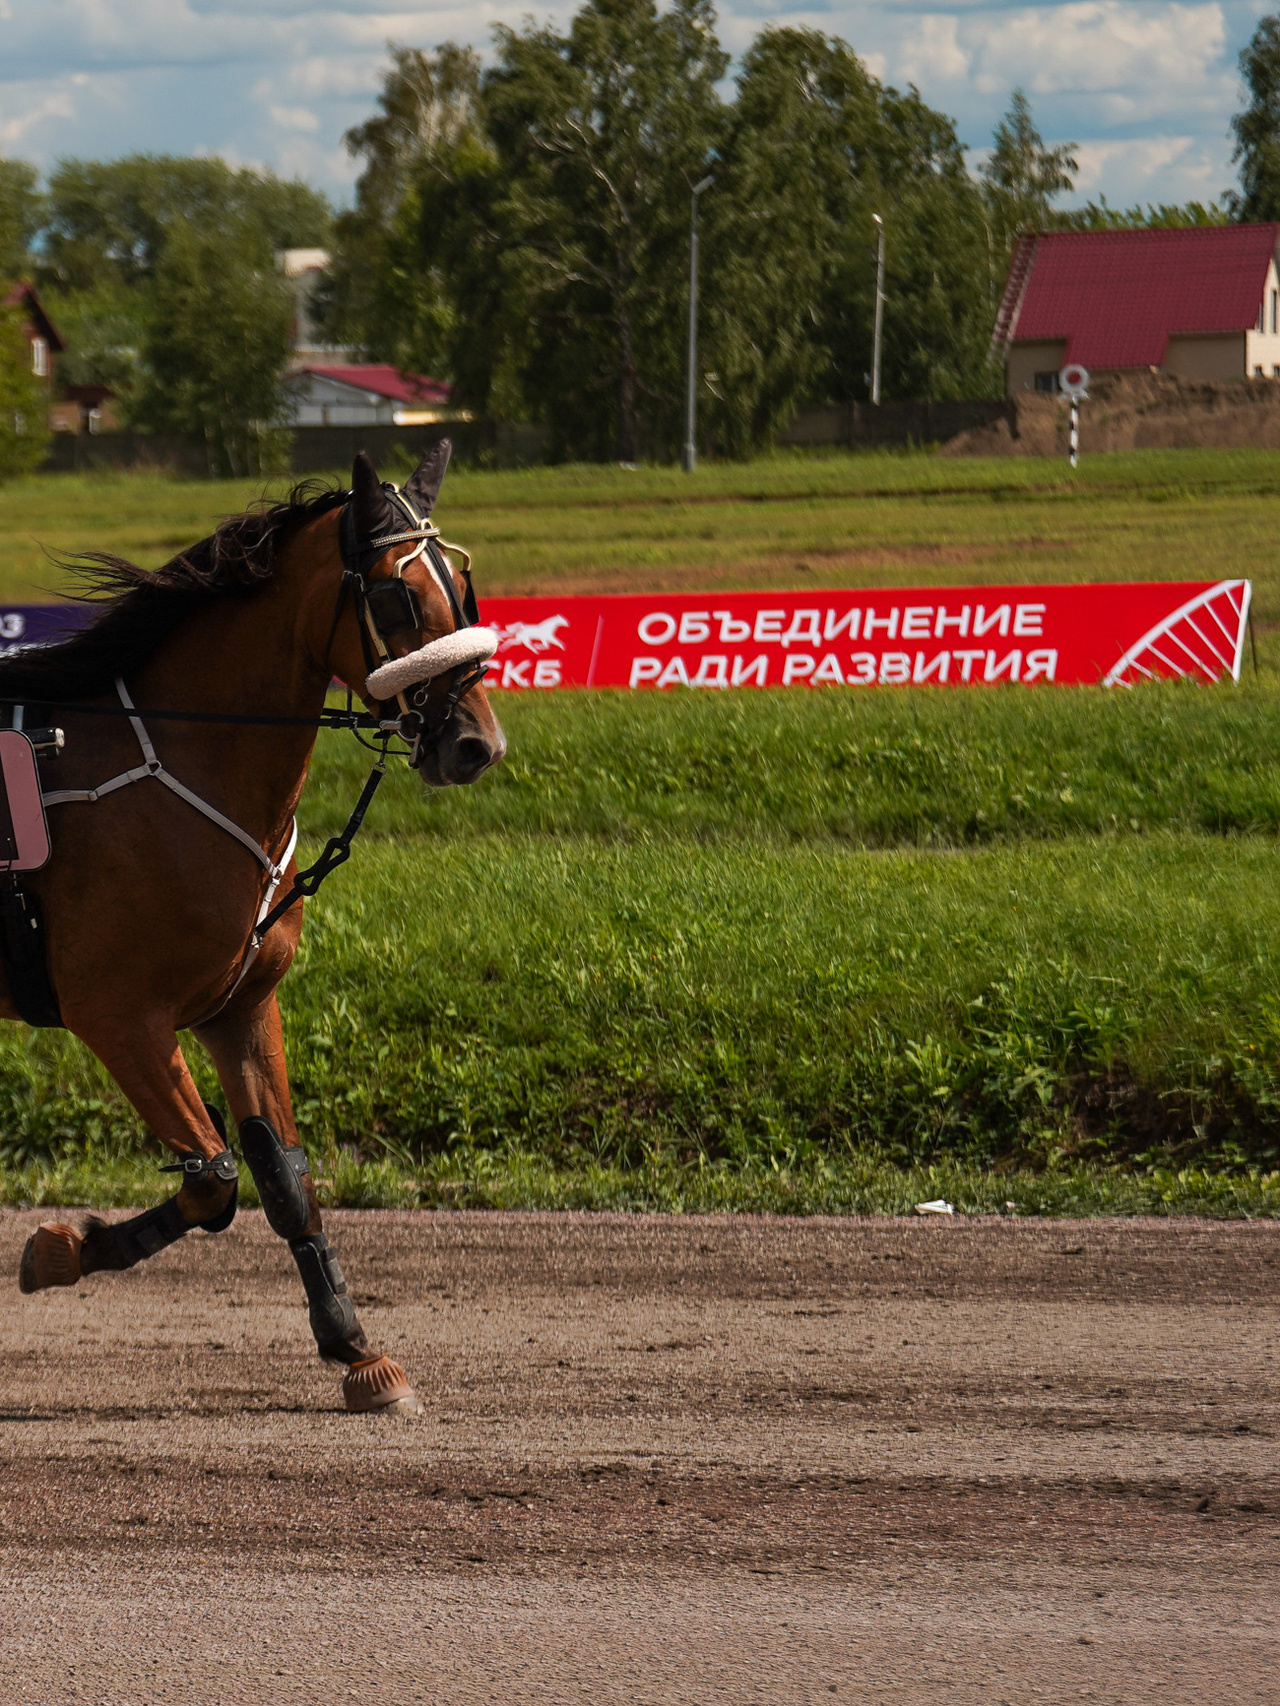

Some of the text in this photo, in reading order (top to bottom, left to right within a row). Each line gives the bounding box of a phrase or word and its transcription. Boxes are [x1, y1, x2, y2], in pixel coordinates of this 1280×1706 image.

[637, 603, 1047, 648] ОБЪЕДИНЕНИЕ
[628, 648, 1059, 690] РАДИ РАЗВИТИЯ
